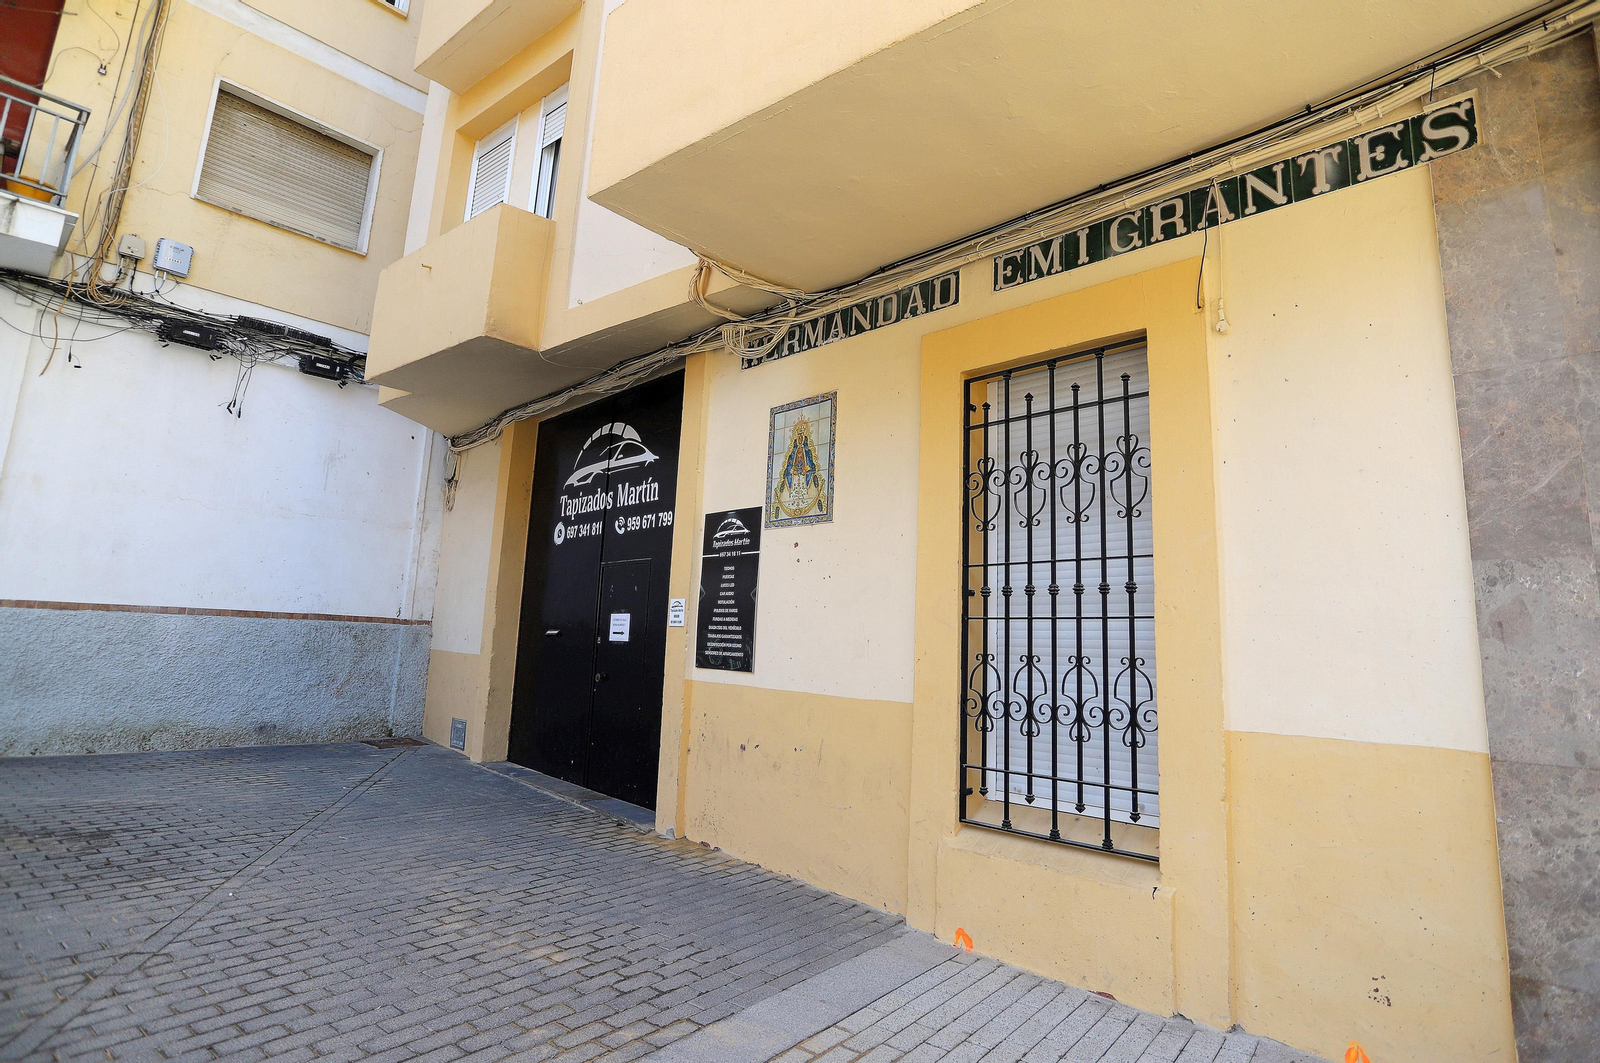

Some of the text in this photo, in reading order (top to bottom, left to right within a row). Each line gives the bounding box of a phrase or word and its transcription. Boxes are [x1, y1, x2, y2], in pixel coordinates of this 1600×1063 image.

[994, 101, 1471, 291] EMIGRANTES
[560, 477, 659, 520] Tapizados Martín
[566, 526, 578, 539] 697
[579, 524, 590, 537] 341
[627, 511, 673, 531] 959 671 799
